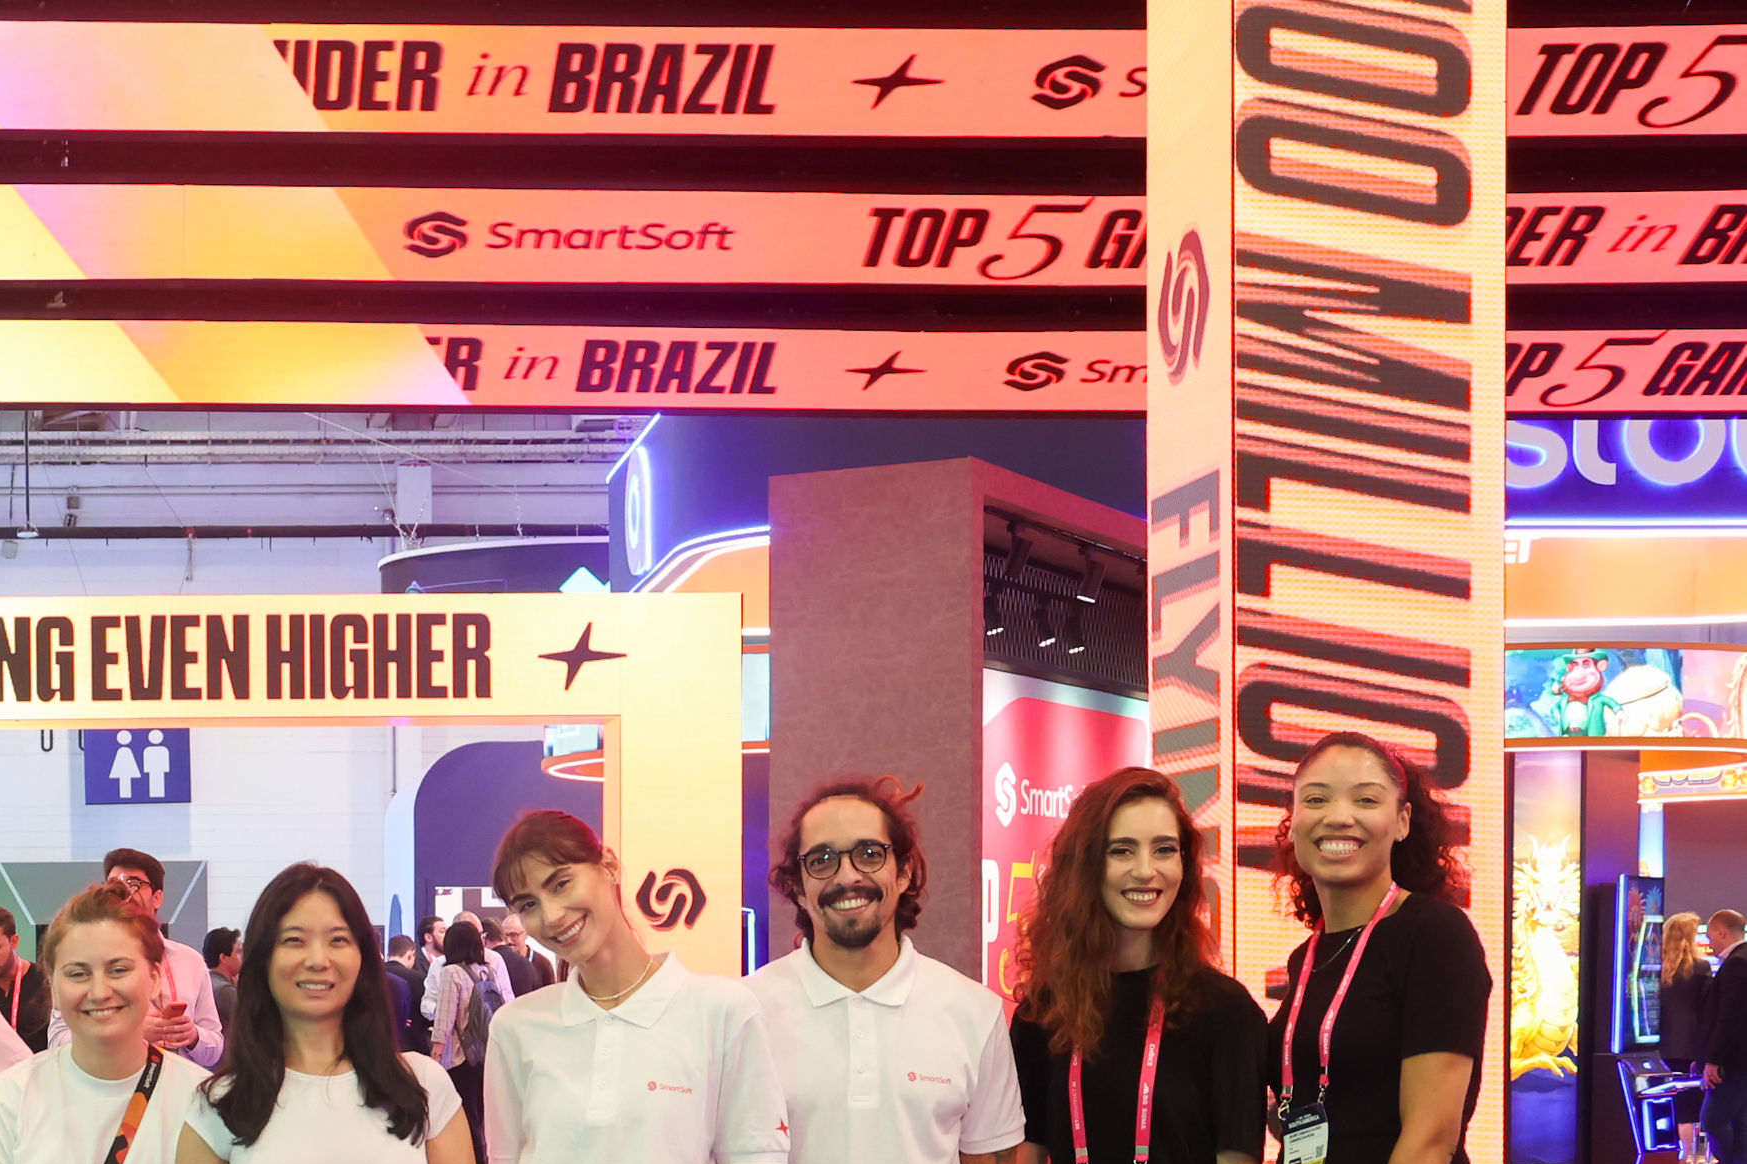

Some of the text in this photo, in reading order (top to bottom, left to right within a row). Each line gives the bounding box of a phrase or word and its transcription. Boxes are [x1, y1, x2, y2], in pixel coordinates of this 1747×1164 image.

[466, 52, 530, 98] in
[548, 43, 777, 115] BRAZIL
[1236, 0, 1473, 227] 00
[1515, 34, 1747, 128] TOP 5
[484, 221, 735, 252] SmartSoft
[863, 207, 989, 270] TOP
[977, 197, 1096, 280] 5
[1607, 215, 1678, 255] in
[503, 346, 561, 381] in
[576, 339, 778, 395] BRAZIL
[1540, 329, 1671, 407] 5
[91, 614, 249, 701] EVEN
[265, 612, 492, 700] HIGHER
[1020, 779, 1077, 819] SmartS
[659, 1083, 693, 1095] SmartSoft
[919, 1074, 952, 1085] SmartSoft
